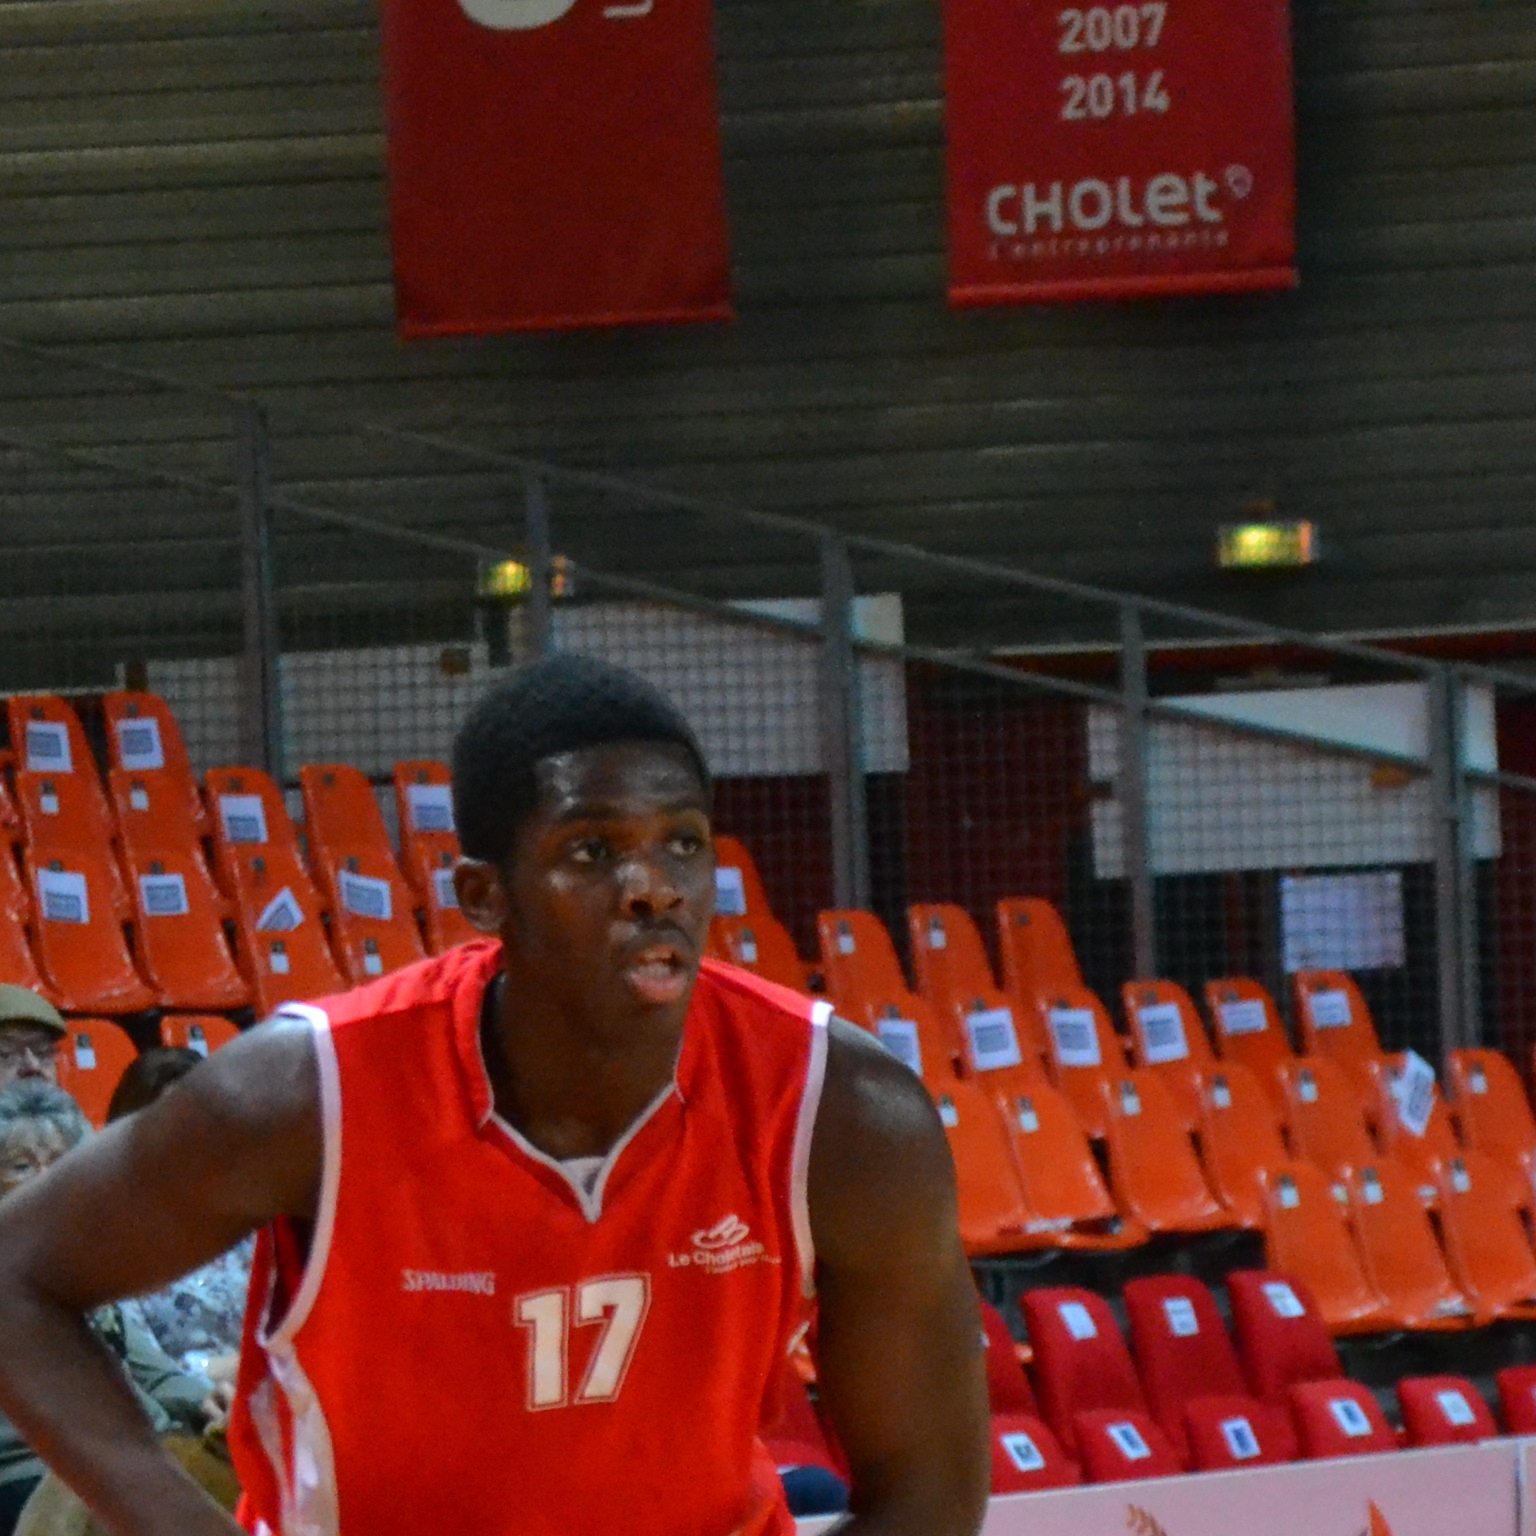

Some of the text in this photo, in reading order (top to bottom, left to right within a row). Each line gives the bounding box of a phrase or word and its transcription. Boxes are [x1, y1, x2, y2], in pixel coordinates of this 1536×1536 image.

[1058, 2, 1166, 54] 2007
[1059, 70, 1172, 121] 2014
[401, 1267, 496, 1296] SPALDING
[512, 1271, 652, 1413] 17
